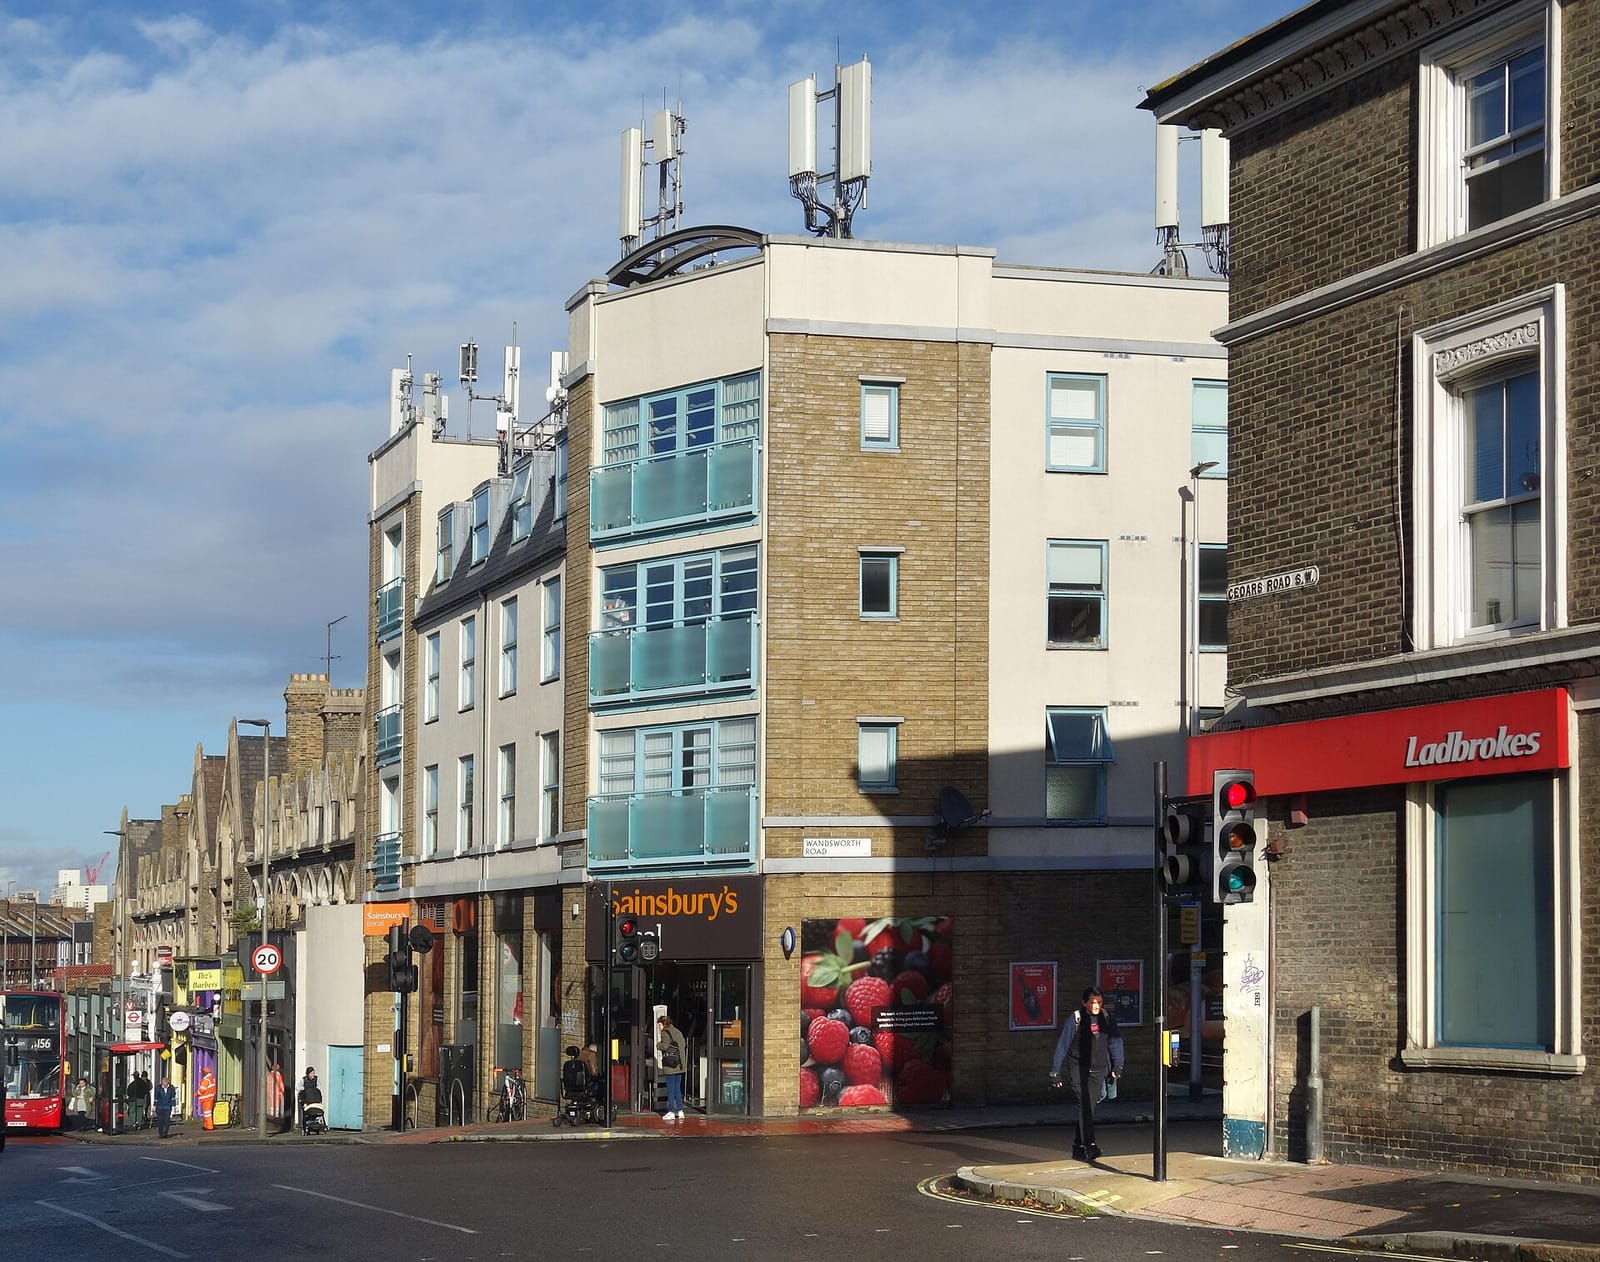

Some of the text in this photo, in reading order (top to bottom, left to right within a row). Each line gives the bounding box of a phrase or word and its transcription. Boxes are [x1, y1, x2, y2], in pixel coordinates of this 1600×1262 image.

[1228, 582, 1263, 600] CEDARS
[1266, 575, 1291, 592] ROAD
[1404, 725, 1542, 767] Ladbrokes
[805, 839, 861, 847] WANDSWORTH
[805, 847, 828, 855] ROAD
[257, 953, 278, 966] 20
